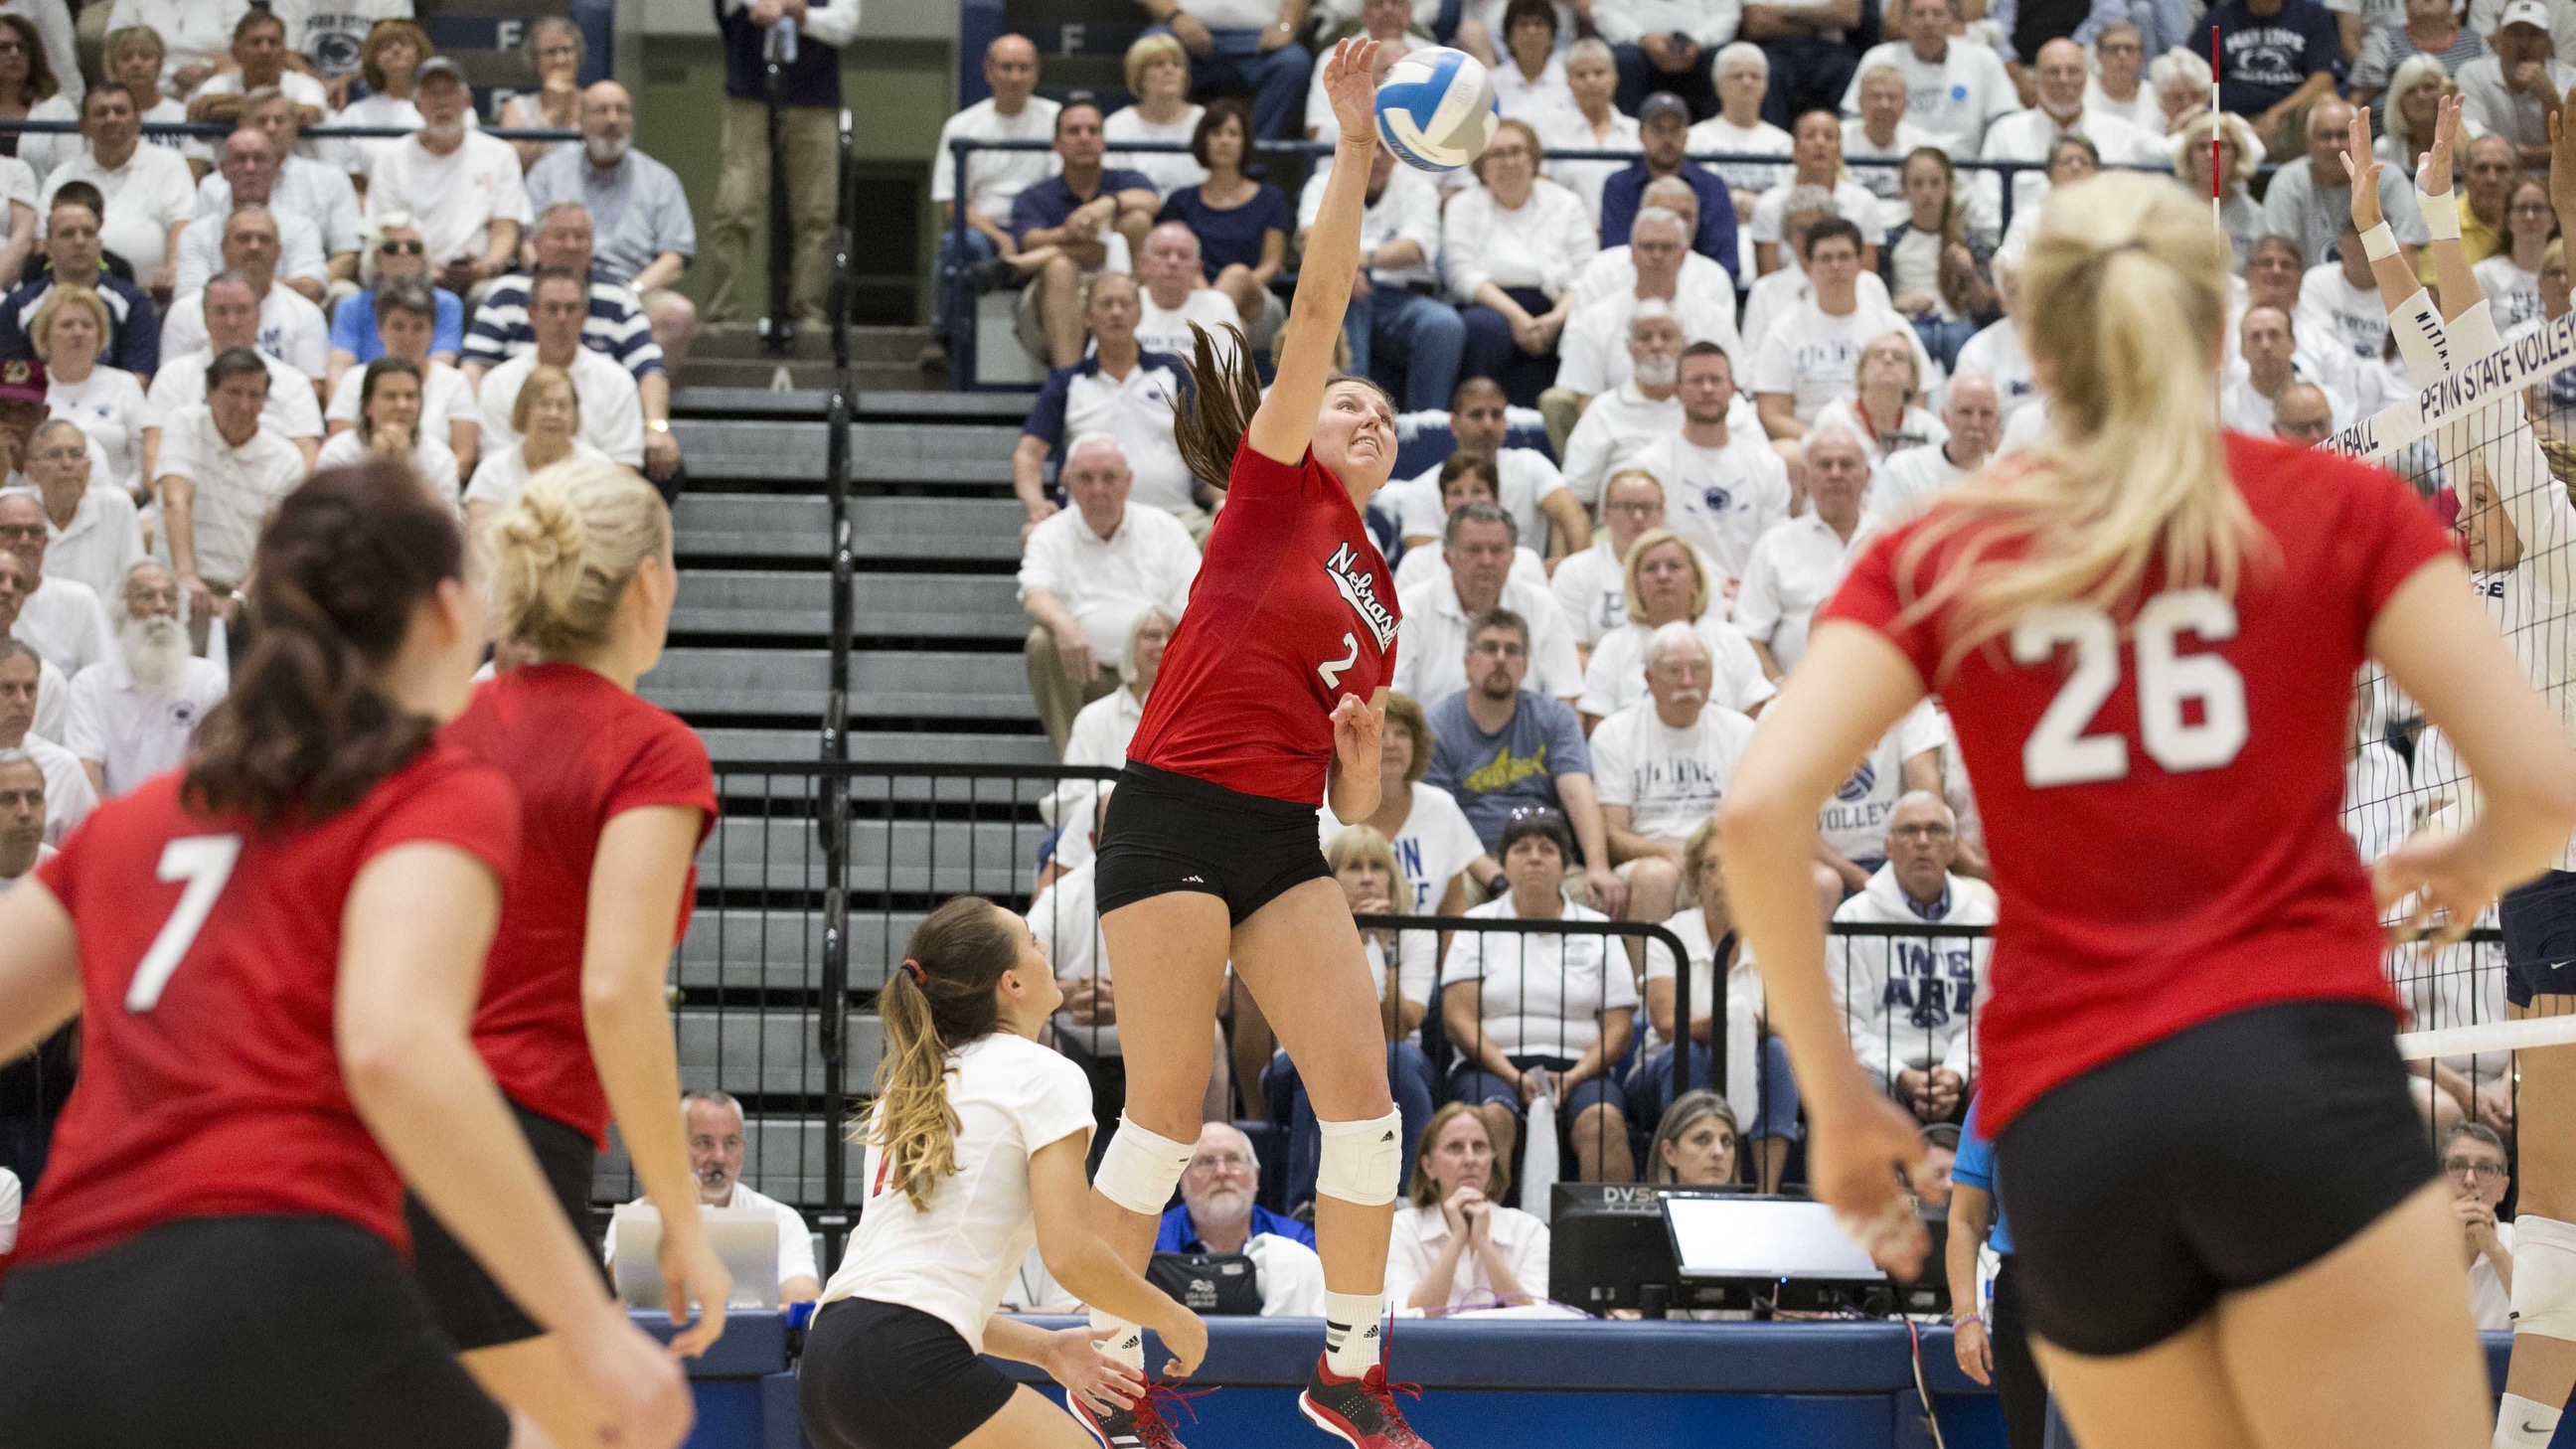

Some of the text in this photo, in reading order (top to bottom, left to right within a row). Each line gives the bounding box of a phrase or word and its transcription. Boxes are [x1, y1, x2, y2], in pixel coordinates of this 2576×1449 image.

[499, 20, 522, 52] F
[1060, 24, 1086, 58] F
[770, 366, 795, 394] A
[2420, 372, 2462, 424] PENN
[2464, 346, 2511, 401] STATE
[1317, 631, 1360, 691] 2
[2010, 584, 2251, 790] 26
[123, 832, 244, 1015] 7
